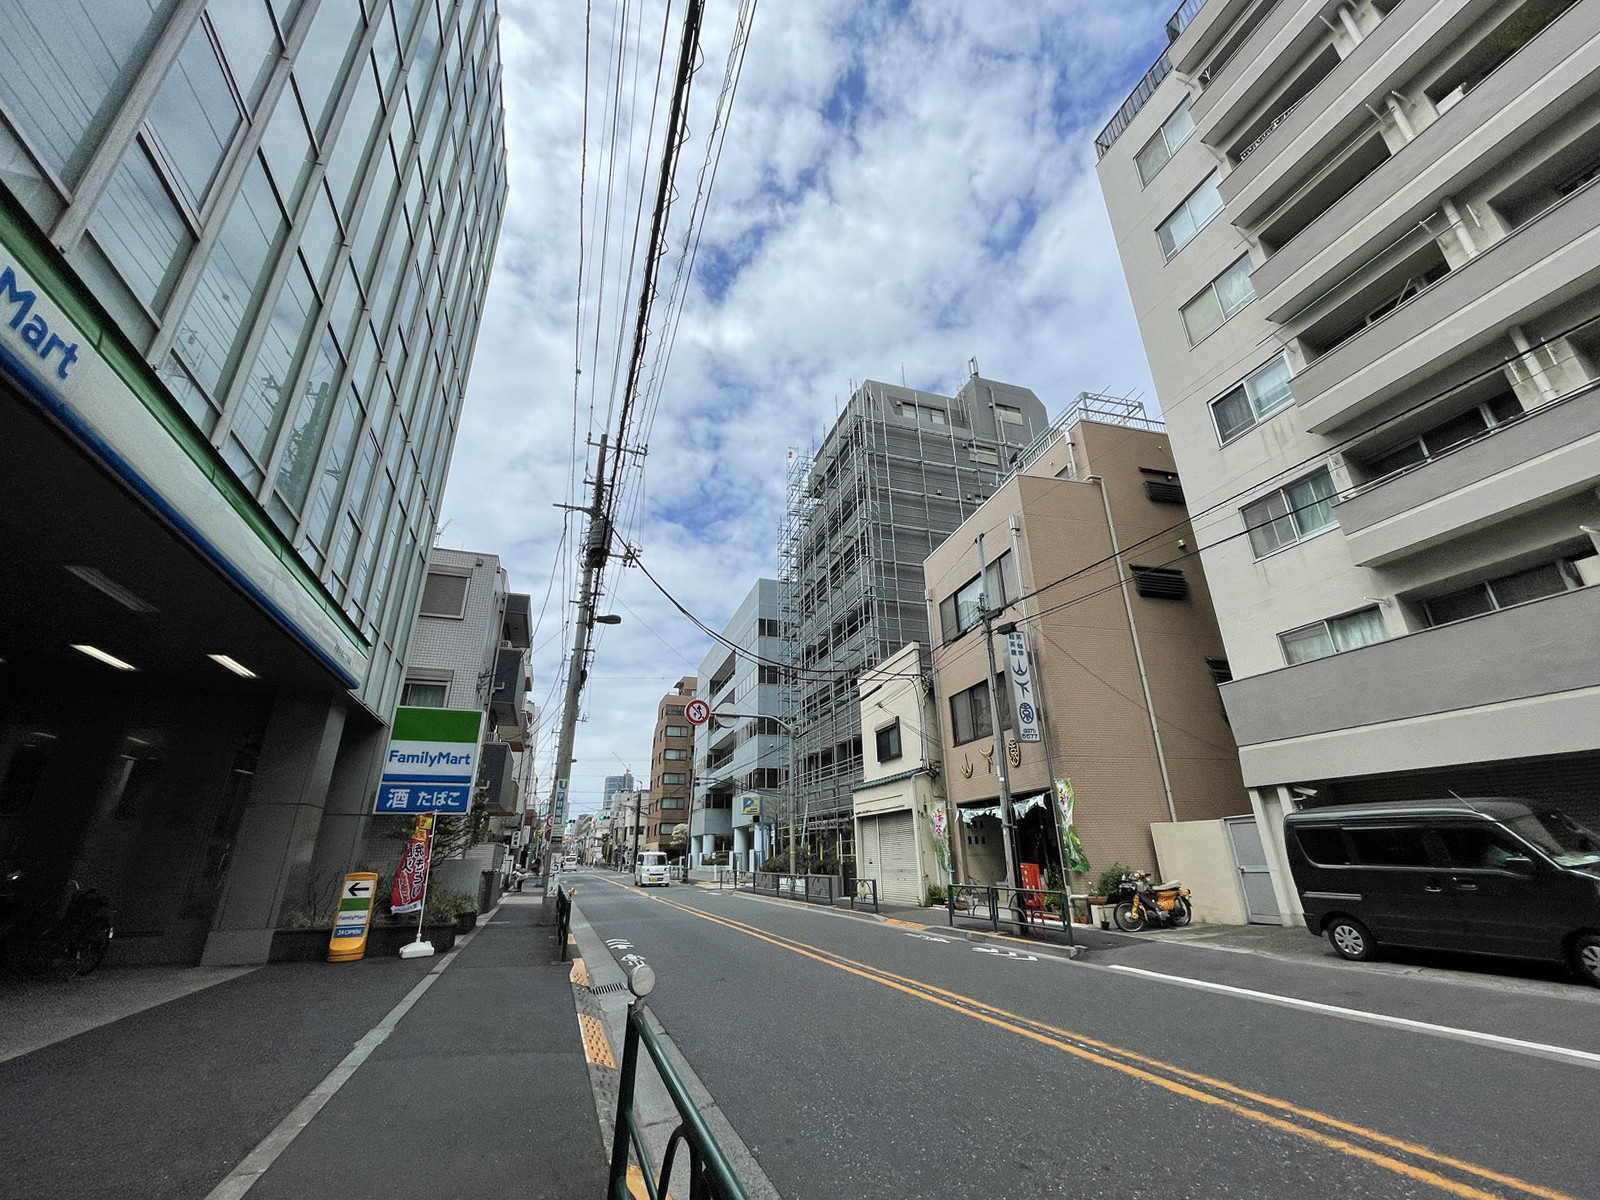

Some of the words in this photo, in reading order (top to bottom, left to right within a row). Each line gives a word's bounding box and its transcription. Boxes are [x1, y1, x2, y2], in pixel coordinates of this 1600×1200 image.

[388, 750, 471, 767] FamilyMart
[386, 788, 411, 809] 酒
[416, 791, 461, 807] たばこ
